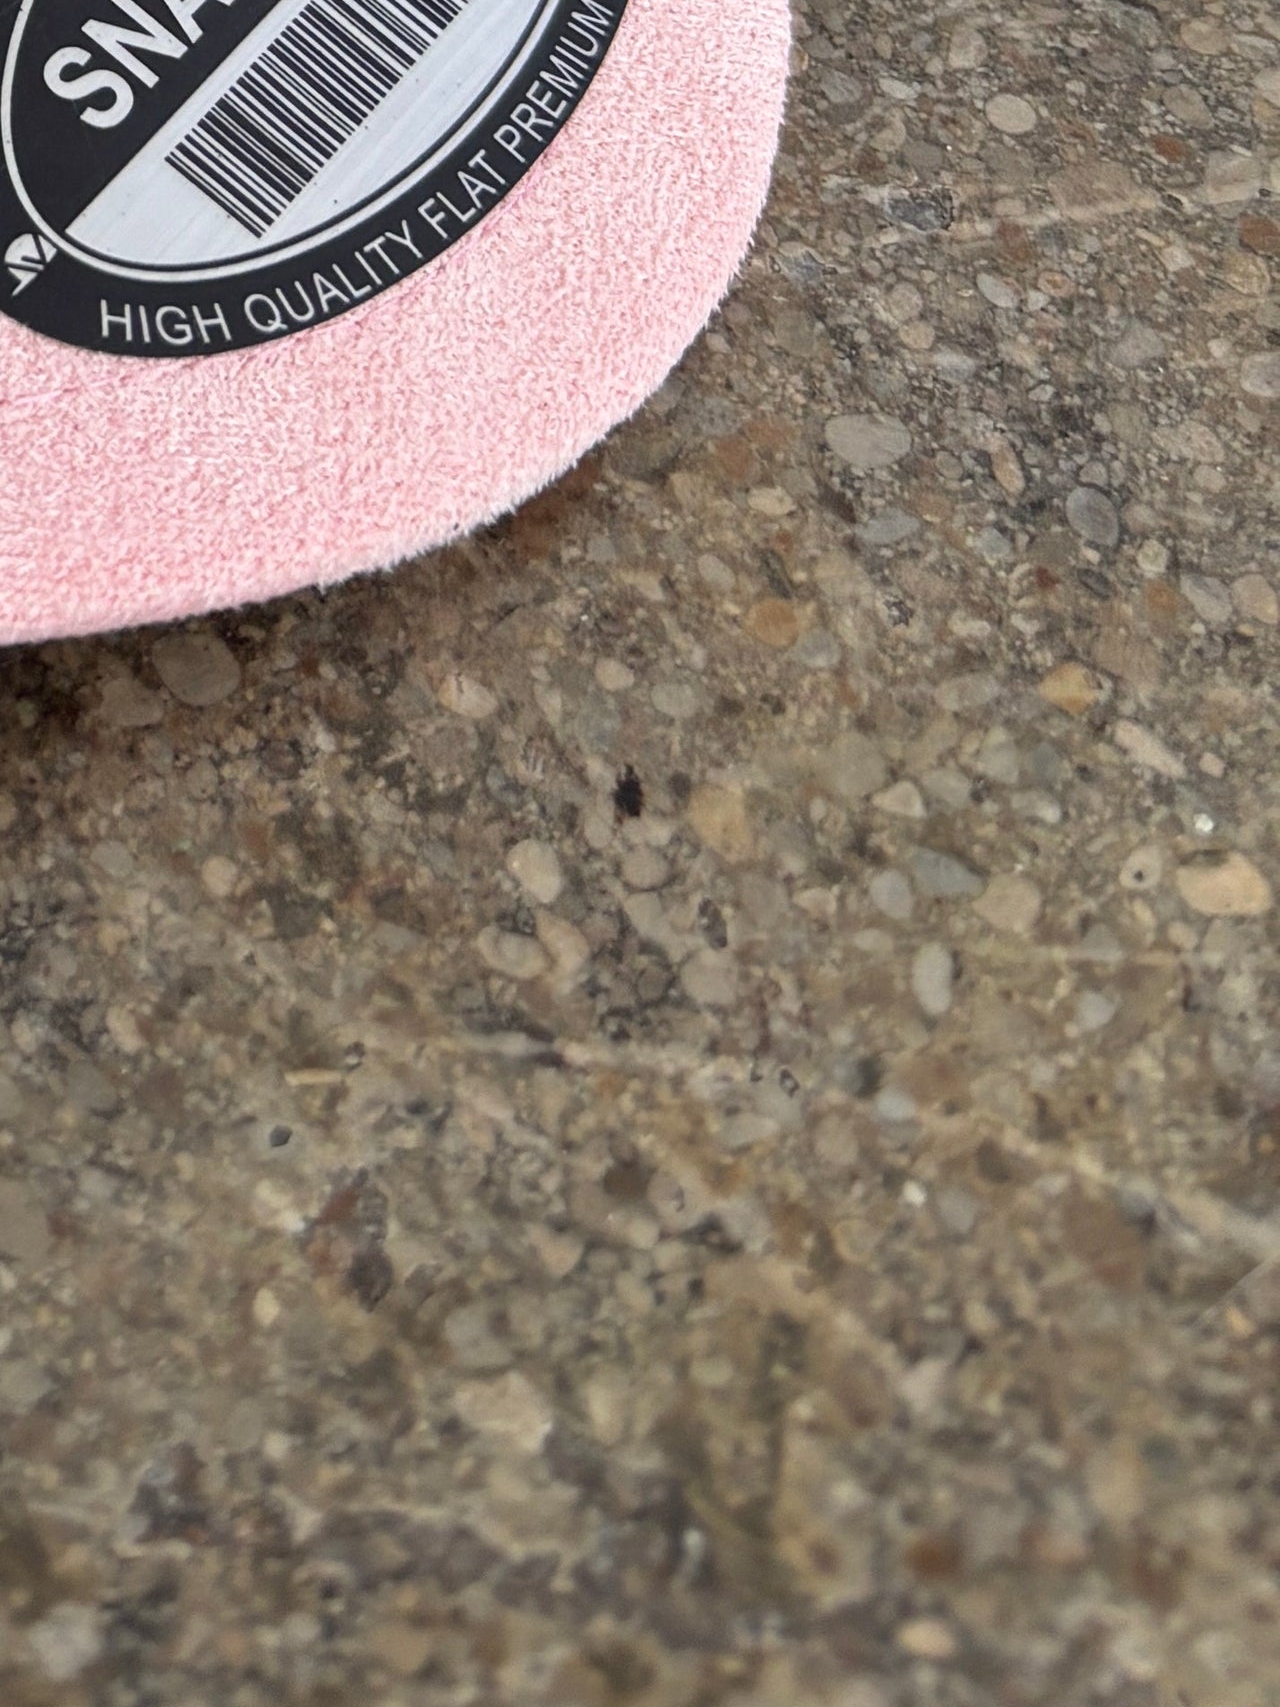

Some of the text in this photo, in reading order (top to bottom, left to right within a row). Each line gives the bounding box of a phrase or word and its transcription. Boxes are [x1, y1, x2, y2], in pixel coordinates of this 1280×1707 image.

[99, 298, 234, 346] HIGH
[243, 223, 424, 335] QUALITY
[419, 148, 508, 239] FLAT
